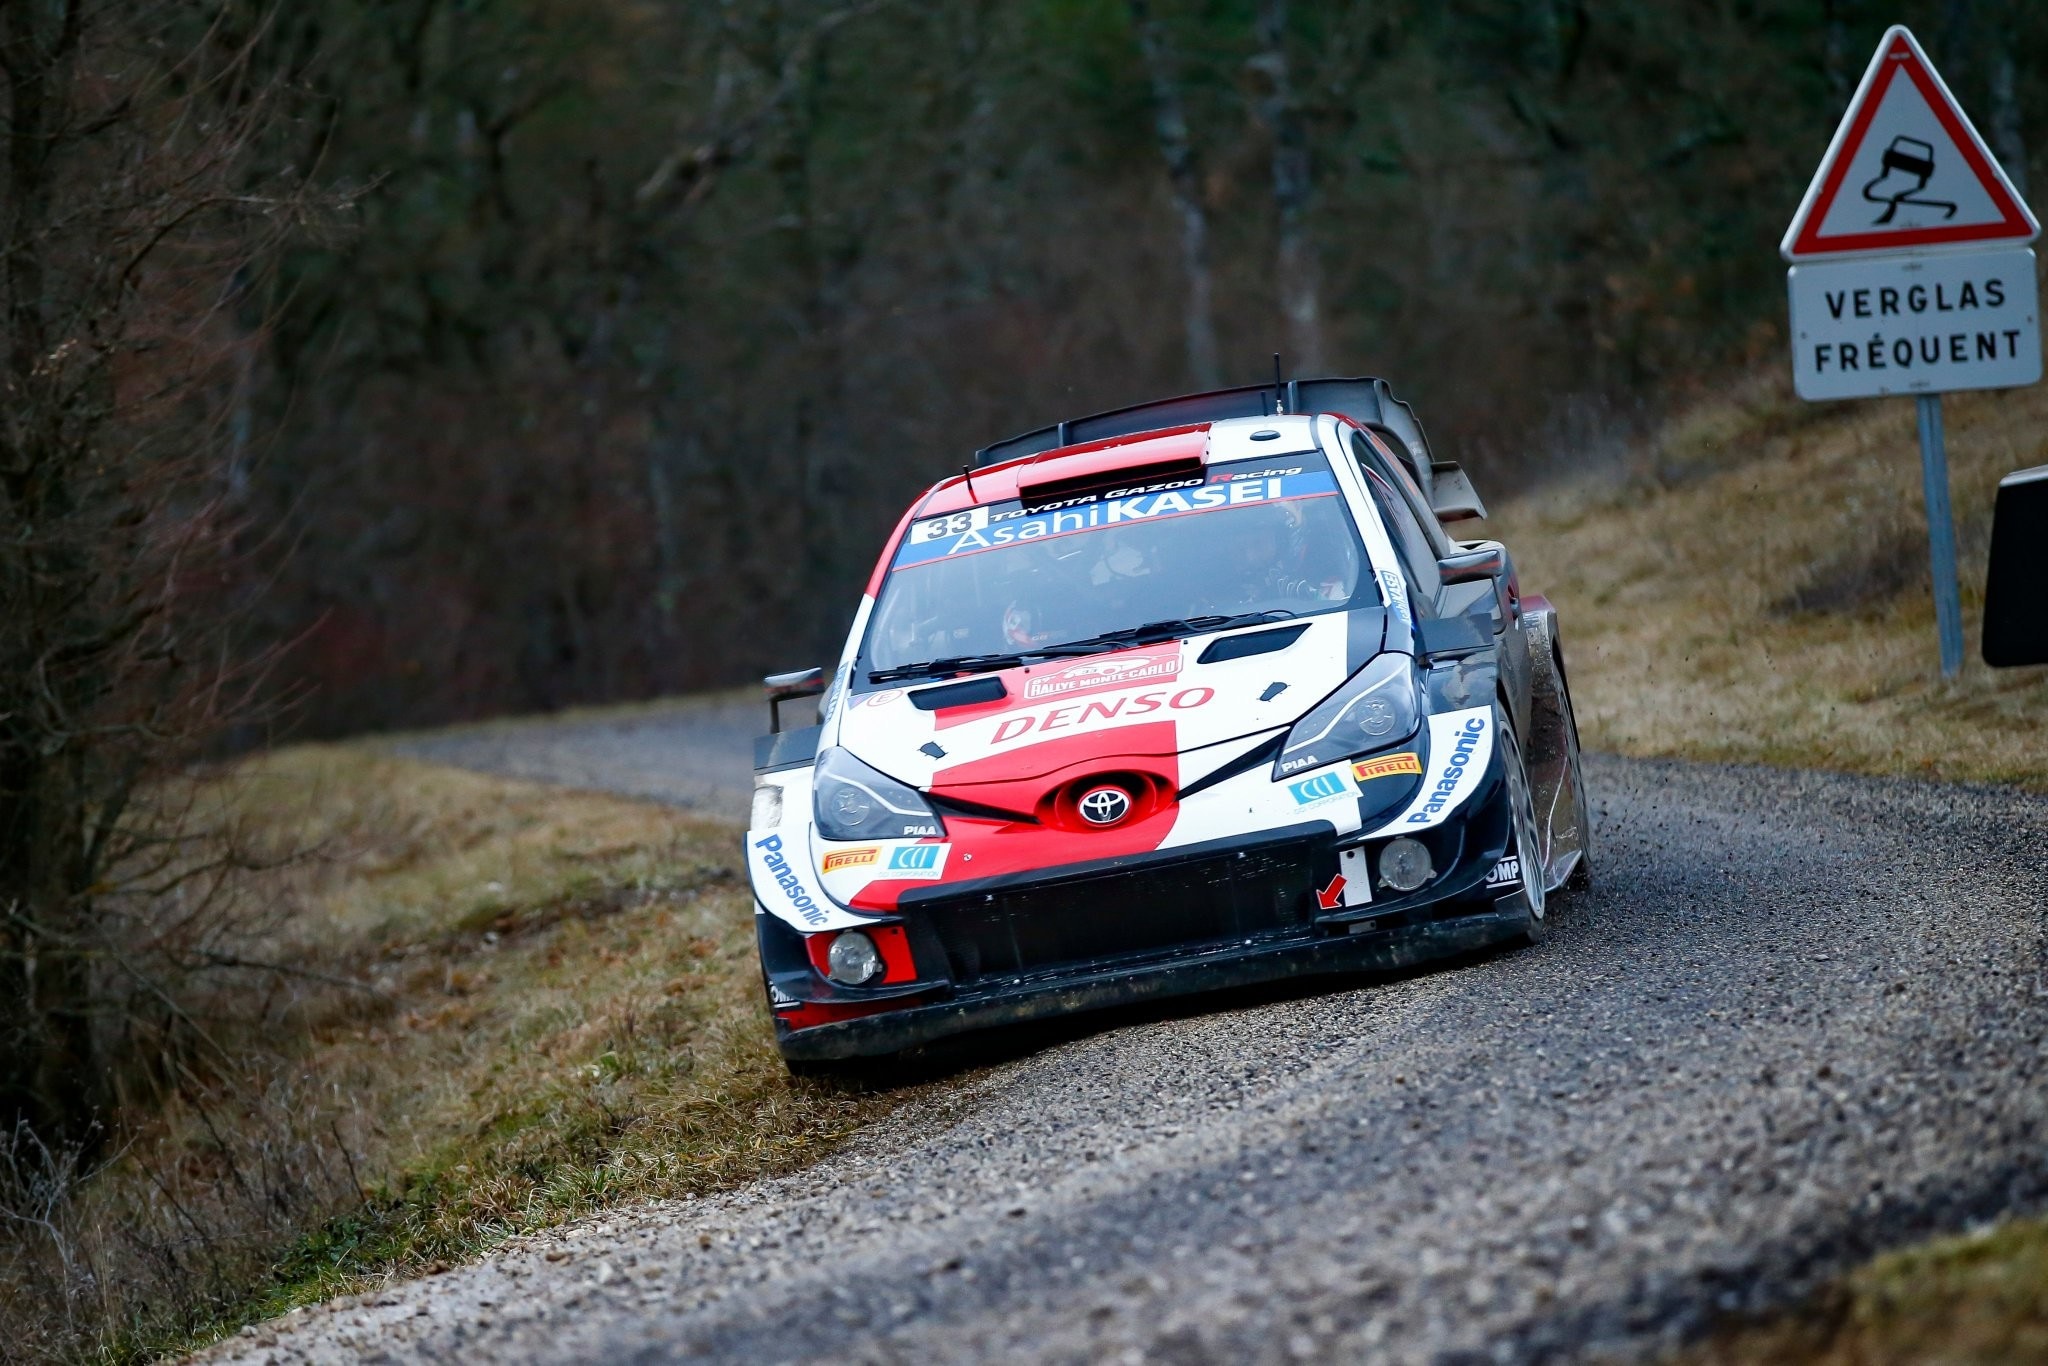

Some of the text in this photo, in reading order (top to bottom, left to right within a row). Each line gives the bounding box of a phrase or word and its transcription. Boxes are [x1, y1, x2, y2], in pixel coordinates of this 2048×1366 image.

[1825, 279, 2006, 319] VERGLAS
[1814, 331, 2021, 374] FRÉQUENT
[990, 466, 1303, 522] TOYOTA GAZOO Racing
[927, 512, 973, 539] 33
[1030, 660, 1177, 697] RALLYE MONTE-CARLO
[990, 687, 1215, 745] DENSO
[1281, 755, 1319, 773] PIAA
[1355, 756, 1417, 777] PIRELLI
[1406, 718, 1485, 823] Panasonic
[903, 825, 937, 836] PIAA
[824, 848, 877, 870] PIRELLI
[755, 833, 830, 926] Panasonic
